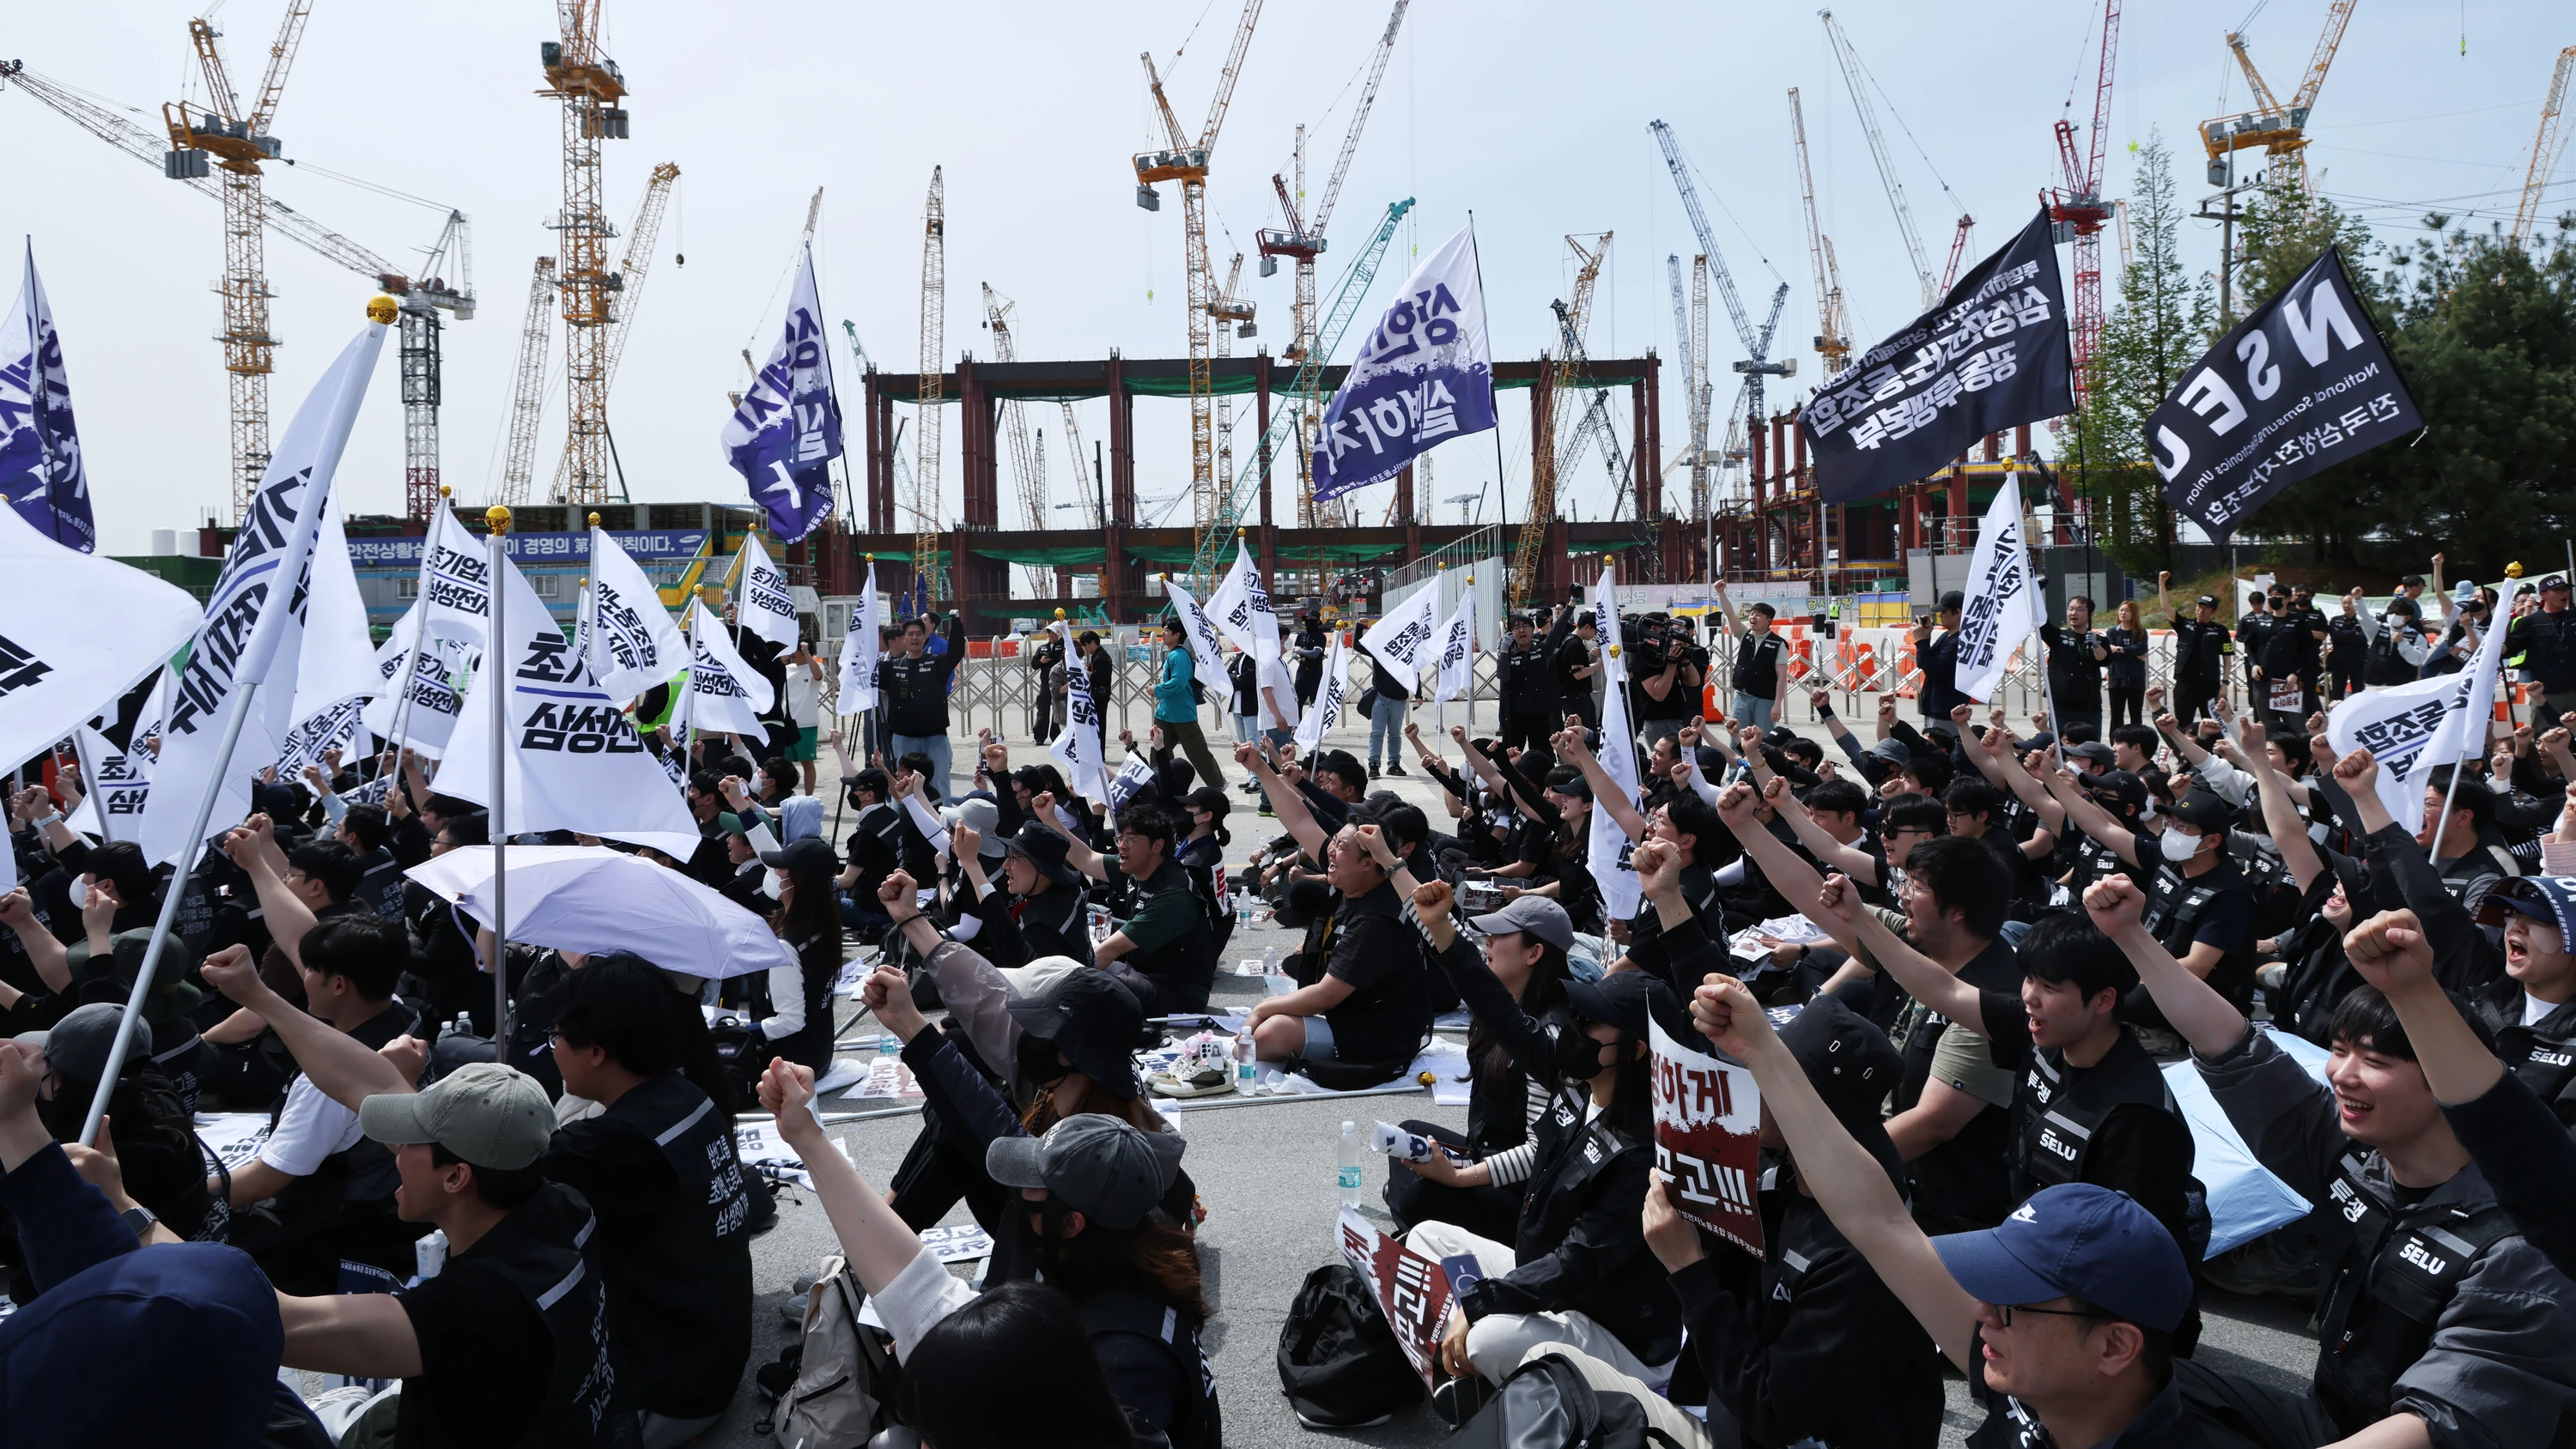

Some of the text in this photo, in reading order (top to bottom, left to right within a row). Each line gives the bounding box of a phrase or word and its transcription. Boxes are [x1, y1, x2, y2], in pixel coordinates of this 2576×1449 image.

[524, 536, 569, 555] 경영의
[2097, 859, 2114, 869] SELU
[2156, 877, 2174, 894] 투쟁
[2282, 876, 2300, 888] SEL
[2186, 896, 2202, 906] SELU
[2529, 1049, 2573, 1067] SELU
[2026, 1070, 2052, 1103] 투쟁
[1551, 1093, 1577, 1127] 투쟁
[1583, 1140, 1603, 1165] SELU
[2039, 1133, 2077, 1161] SELU
[2329, 1176, 2368, 1223] 투쟁
[2399, 1241, 2447, 1276] SELU
